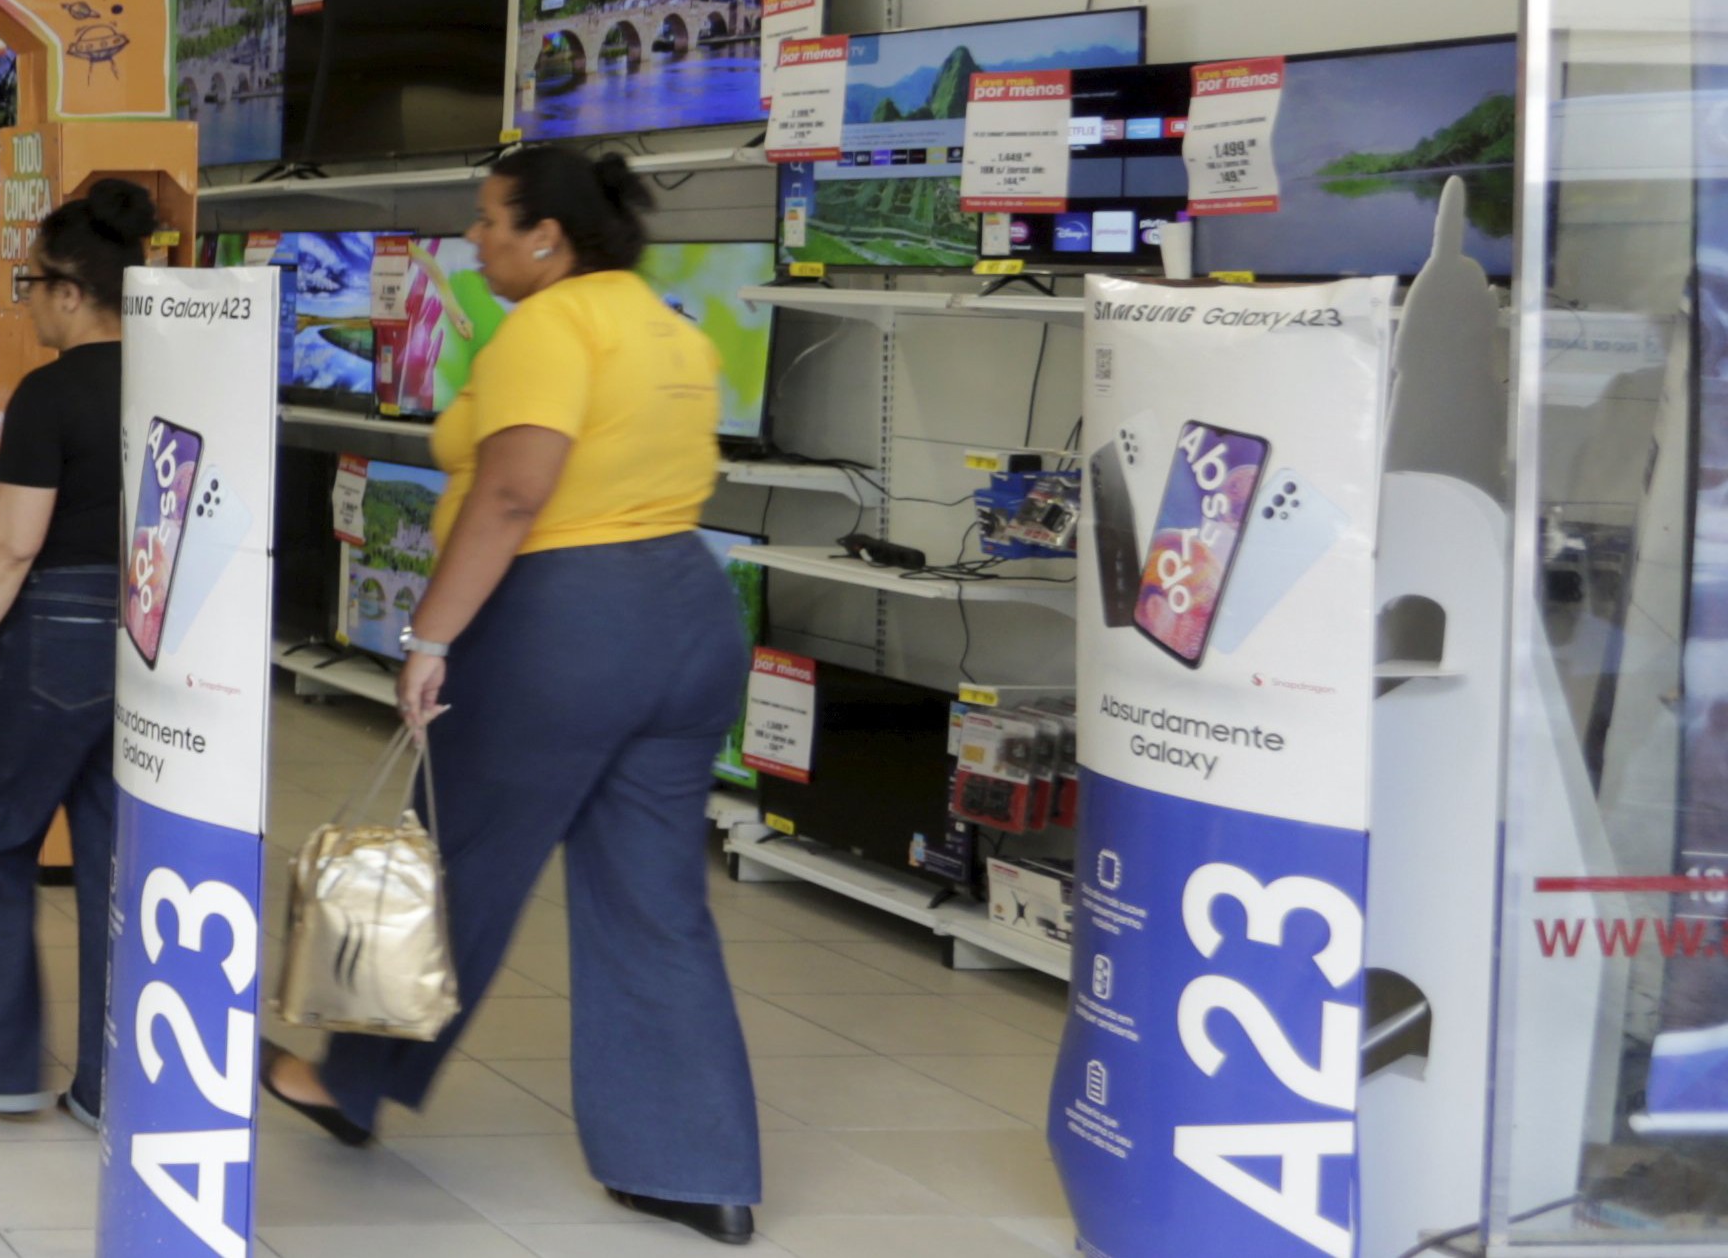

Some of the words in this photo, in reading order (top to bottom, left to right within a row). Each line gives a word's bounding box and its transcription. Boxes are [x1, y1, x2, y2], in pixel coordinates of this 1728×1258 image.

[780, 53, 801, 66] por
[802, 47, 843, 61] menos
[974, 85, 1005, 101] por
[1008, 83, 1064, 98] menos
[975, 77, 1005, 88] Leve
[1006, 77, 1034, 86] mais
[1196, 78, 1224, 94] por
[1226, 71, 1280, 89] menos
[11, 132, 42, 174] TUDO
[161, 297, 221, 325] Galaxy
[219, 297, 252, 319] A23
[1094, 300, 1196, 324] SAMSUNG
[1202, 306, 1290, 333] Galaxy
[1285, 308, 1344, 328] A23
[1271, 677, 1337, 695] Snapdragon
[1099, 693, 1286, 753] Absurdamente
[123, 738, 165, 782] Galaxy
[1130, 735, 1219, 781] Galaxy
[130, 866, 257, 1258] A23
[1174, 862, 1364, 1258] A23
